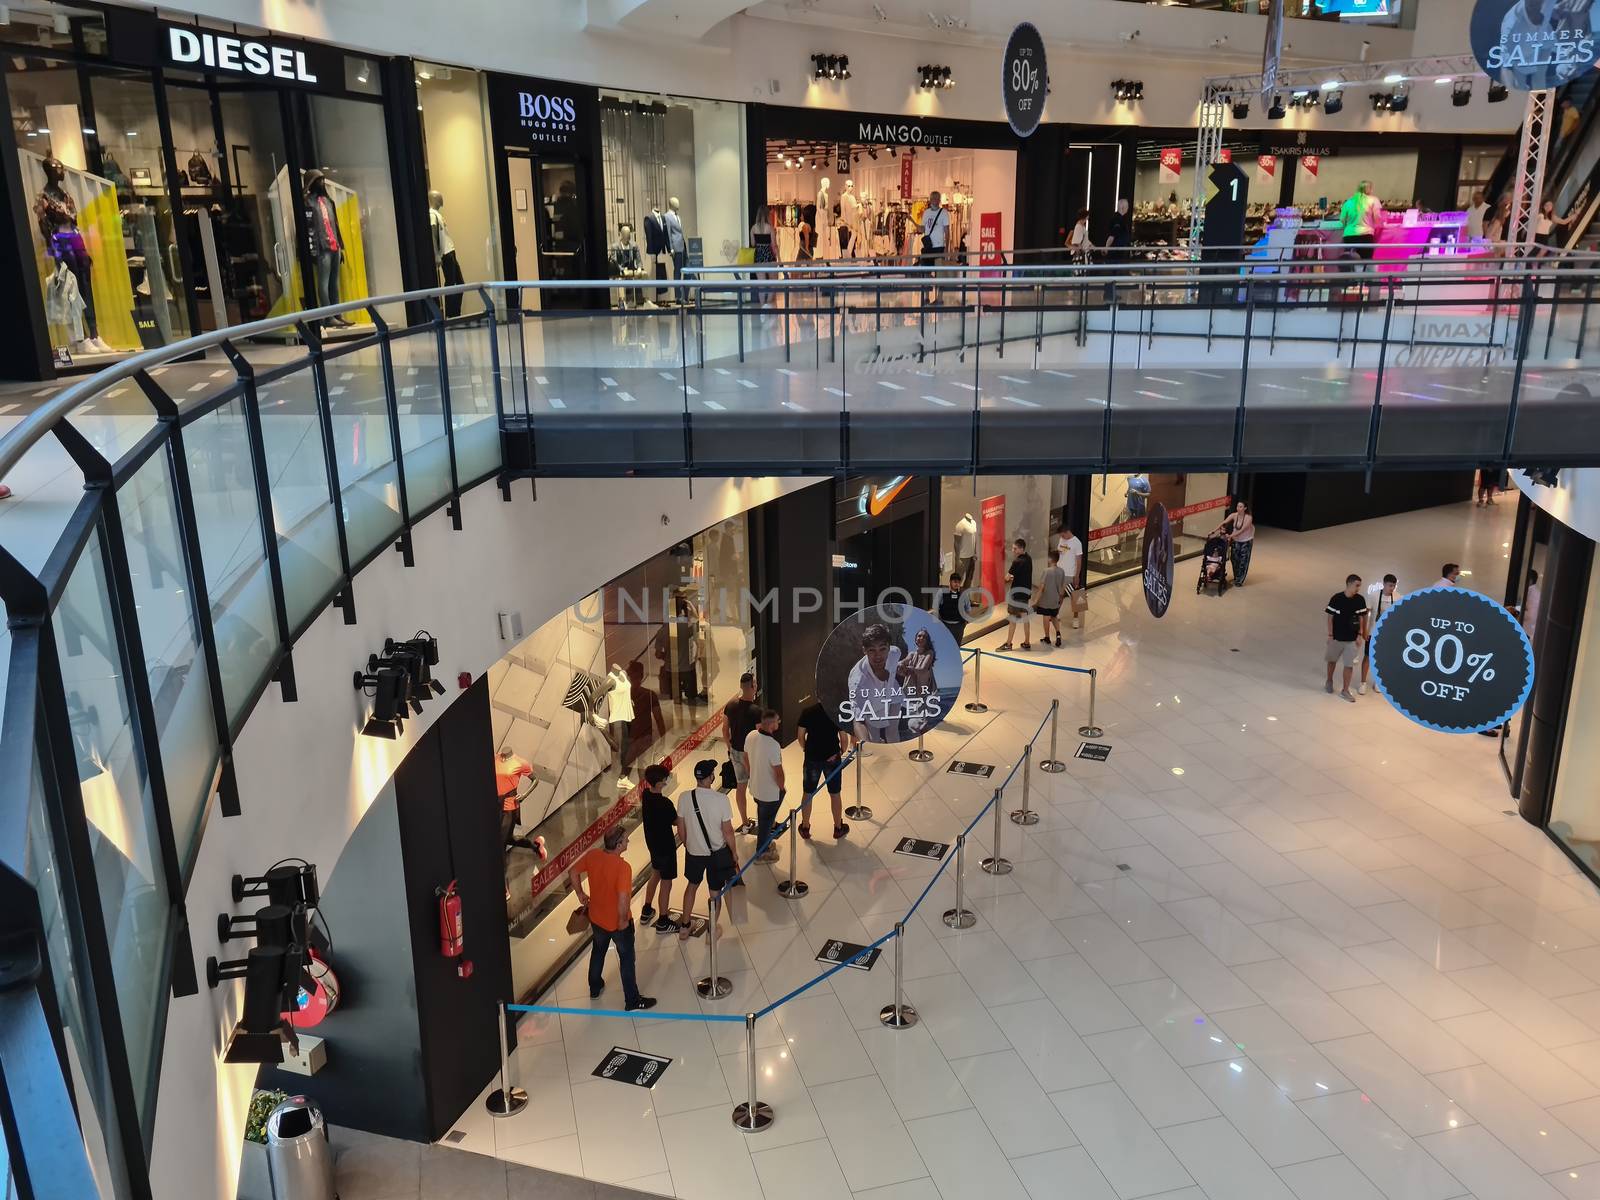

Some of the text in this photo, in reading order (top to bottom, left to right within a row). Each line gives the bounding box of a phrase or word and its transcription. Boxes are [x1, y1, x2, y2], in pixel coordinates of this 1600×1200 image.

[1500, 28, 1584, 44] SUMMER
[169, 27, 317, 83] DIESEL
[1486, 39, 1595, 69] SALES
[1012, 59, 1039, 94] 80%
[518, 92, 576, 122] BOSS
[1018, 98, 1032, 111] OFF
[521, 119, 576, 131] HUGO BOSS
[859, 122, 953, 145] MANGO OUTLET
[532, 132, 567, 142] OUTLET
[1270, 146, 1330, 155] TSAKIRIS MALLAS
[838, 159, 848, 170] 70
[1230, 178, 1239, 202] 1
[981, 227, 996, 238] SALE
[981, 241, 995, 260] 70
[138, 320, 156, 329] SALE
[1420, 322, 1491, 338] IMAX
[1143, 569, 1168, 606] SALES
[1430, 617, 1475, 634] UP TO
[1402, 628, 1496, 683] 80%
[848, 685, 931, 699] SUMMER
[1420, 680, 1470, 701] OFF
[838, 695, 942, 723] SALES
[532, 864, 557, 893] SALE
[559, 832, 593, 868] OFERTAS
